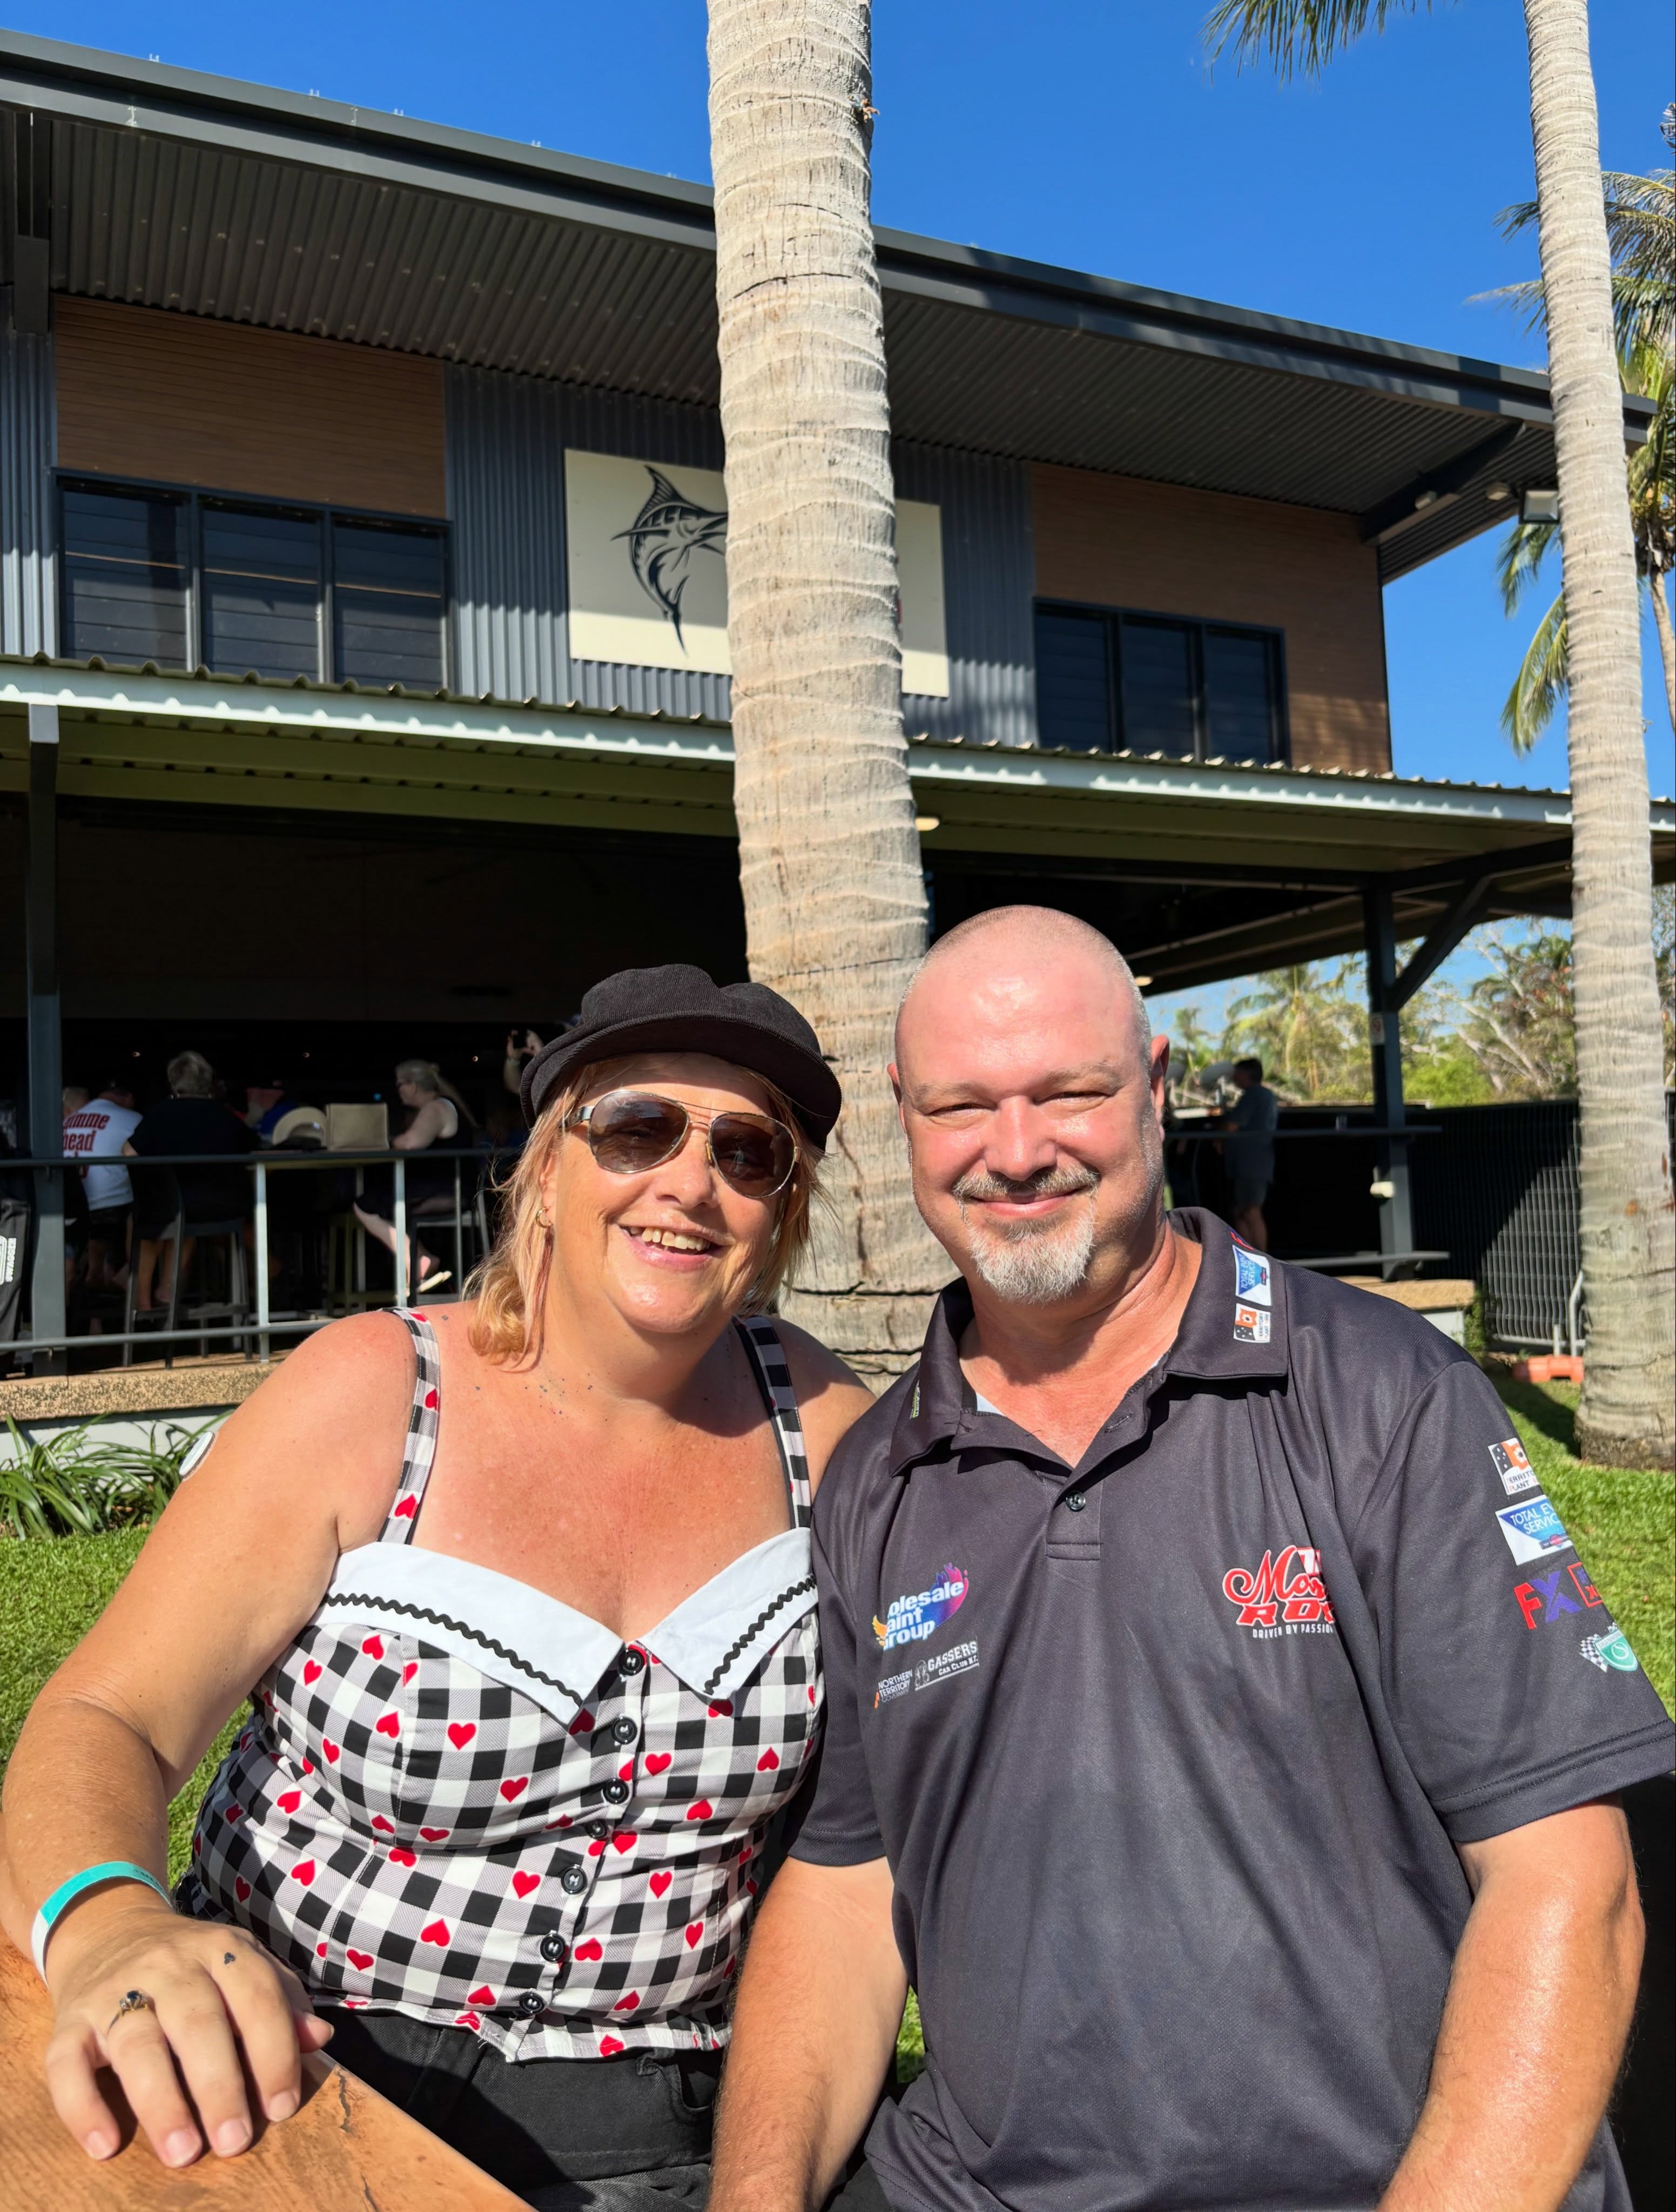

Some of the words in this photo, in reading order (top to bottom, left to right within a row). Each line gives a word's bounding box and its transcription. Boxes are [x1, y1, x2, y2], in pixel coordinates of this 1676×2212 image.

[1510, 1508, 1541, 1526] TOTAL
[1253, 1627, 1282, 1639] DRIVEN
[1285, 1624, 1298, 1635] BY
[927, 1641, 978, 1672] GASSERS
